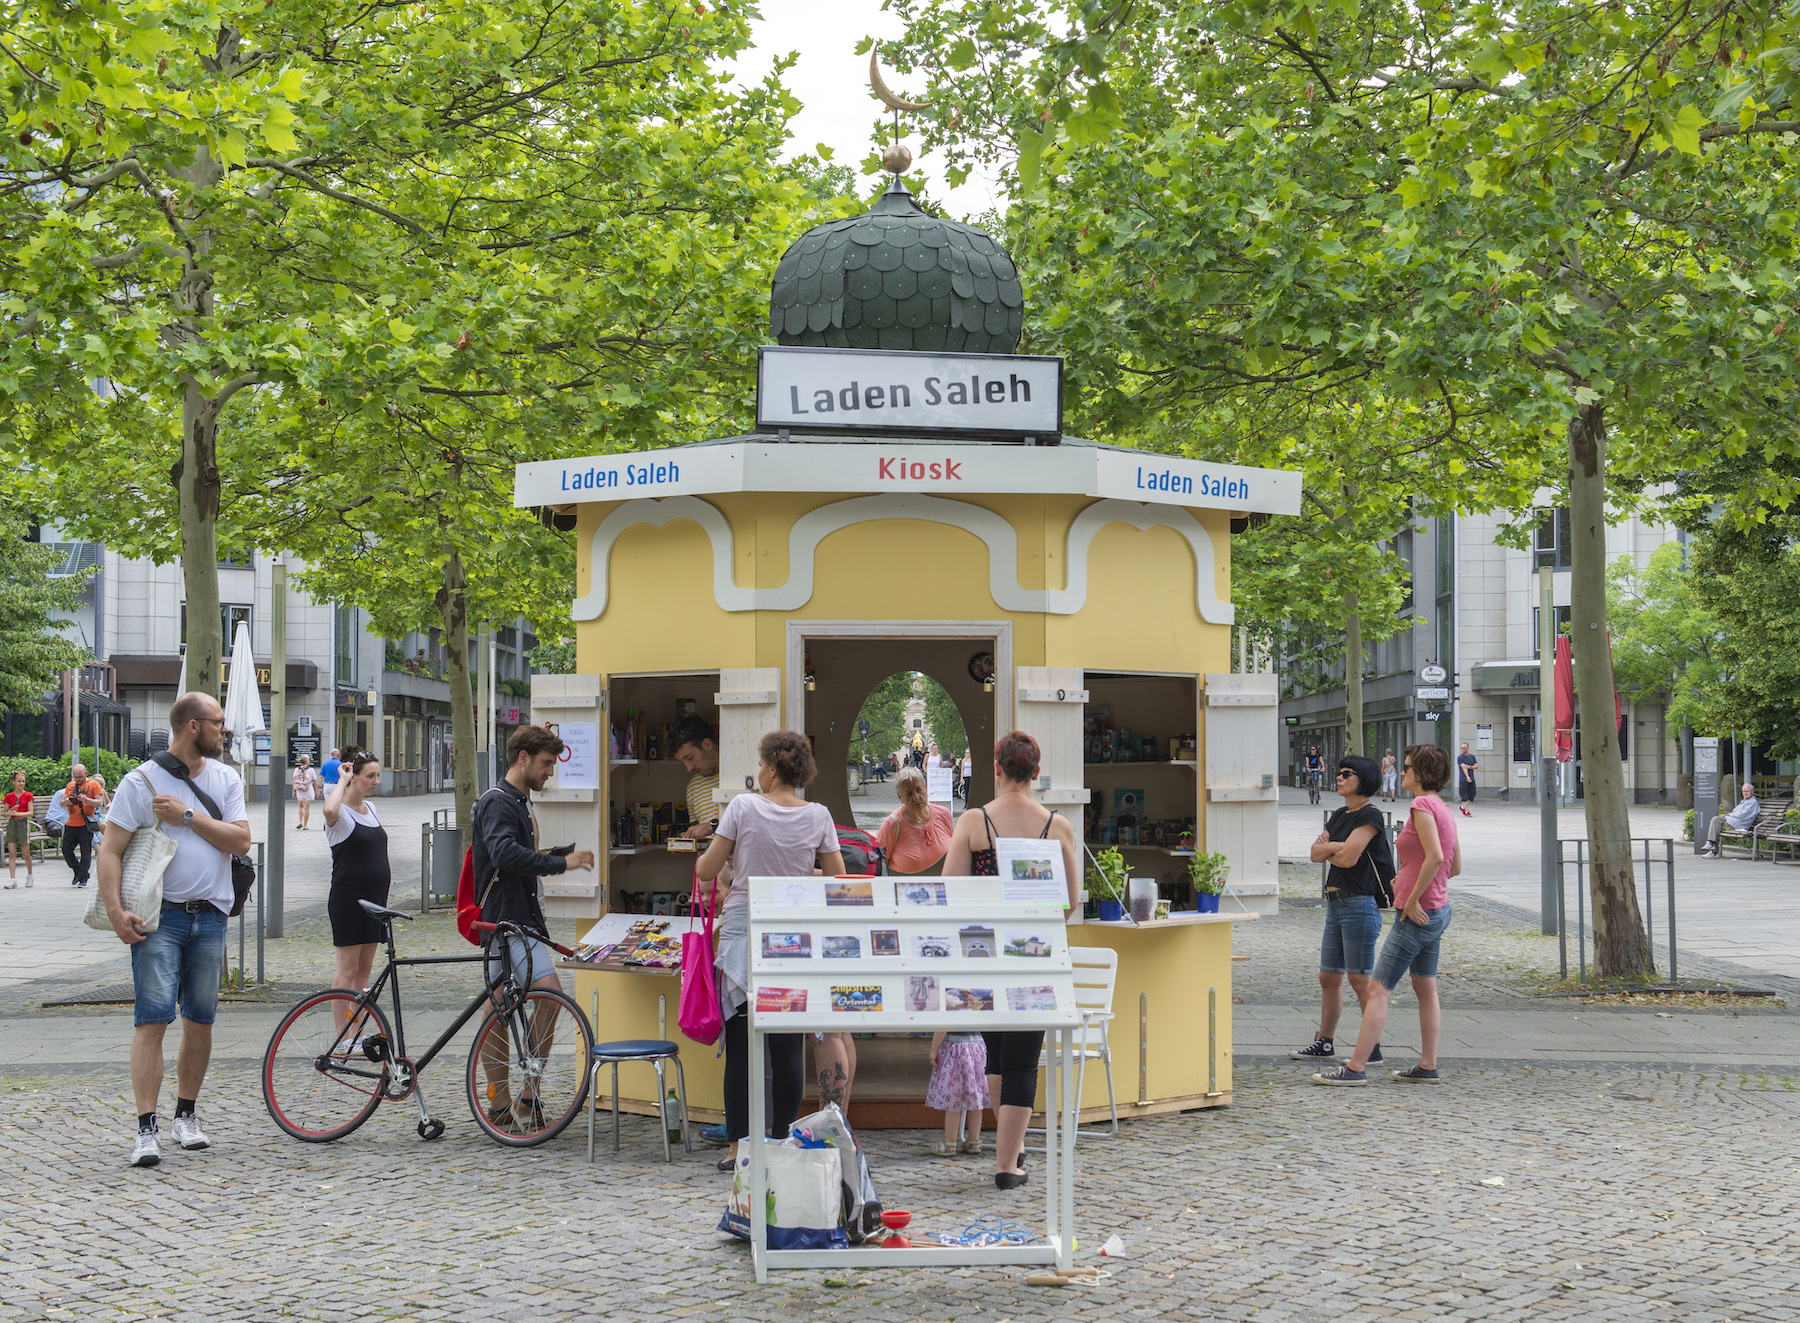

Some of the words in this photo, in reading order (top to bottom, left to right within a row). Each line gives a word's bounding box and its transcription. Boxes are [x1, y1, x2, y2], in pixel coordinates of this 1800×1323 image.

[790, 381, 911, 415] Laden
[924, 374, 1031, 406] Saleh
[562, 468, 618, 491] Laden
[626, 461, 680, 486] Saleh
[878, 457, 963, 480] Kiosk
[1137, 467, 1193, 494] Laden
[1201, 474, 1249, 500] Saleh
[508, 709, 518, 720] T
[1425, 712, 1440, 721] sky
[837, 996, 877, 1006] Oriental
